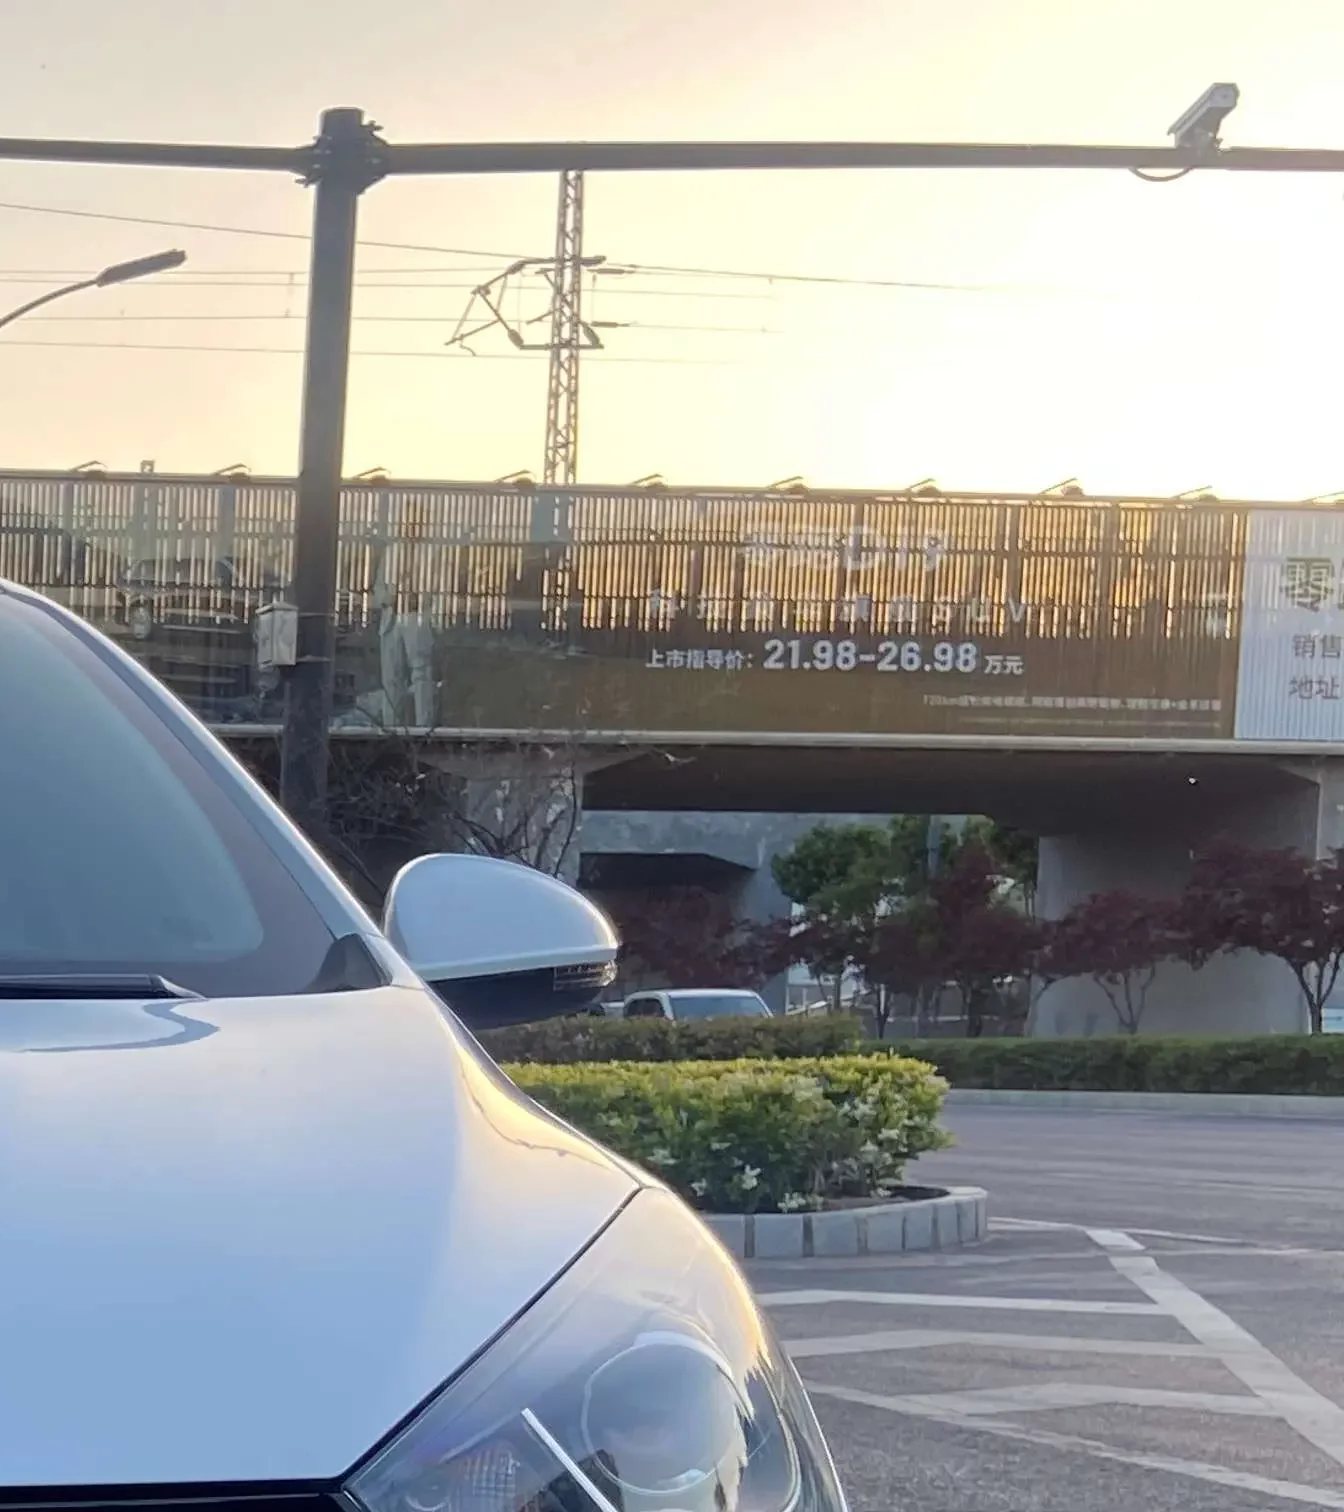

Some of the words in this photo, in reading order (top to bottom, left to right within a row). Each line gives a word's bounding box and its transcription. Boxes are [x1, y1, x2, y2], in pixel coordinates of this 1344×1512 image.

[1280, 557, 1344, 612] 零
[763, 639, 977, 673] 21.98-26.98
[984, 655, 1024, 675] 万元
[1293, 634, 1341, 659] 销售
[1289, 676, 1340, 699] 地址
